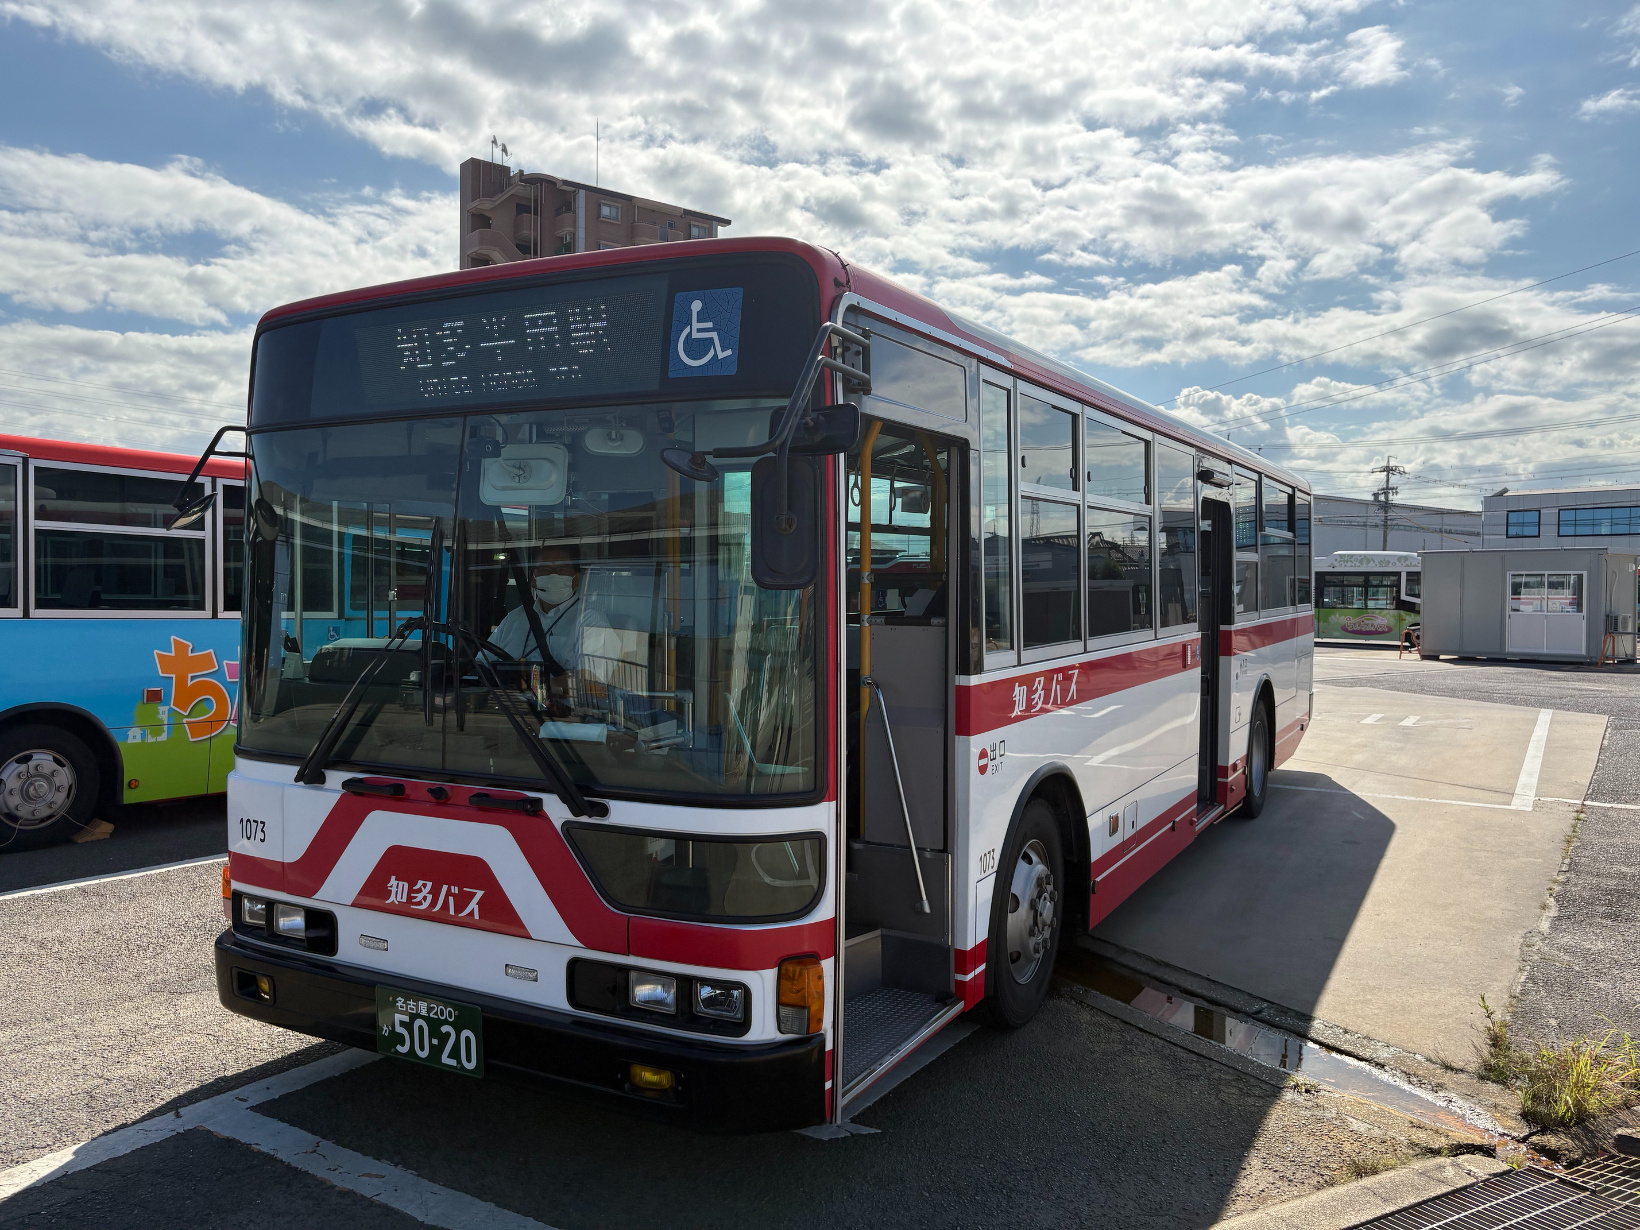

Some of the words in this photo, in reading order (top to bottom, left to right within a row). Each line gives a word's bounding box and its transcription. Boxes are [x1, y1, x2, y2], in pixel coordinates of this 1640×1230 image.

[153, 635, 239, 742] ち
[1011, 669, 1079, 718] 知多バス
[989, 739, 1006, 762] 出口
[991, 761, 1004, 775] EXIT
[239, 817, 267, 843] 1073
[978, 848, 996, 876] 1073
[385, 875, 486, 920] 知多バス
[381, 1022, 393, 1037] か
[394, 1012, 478, 1071] 50-20
